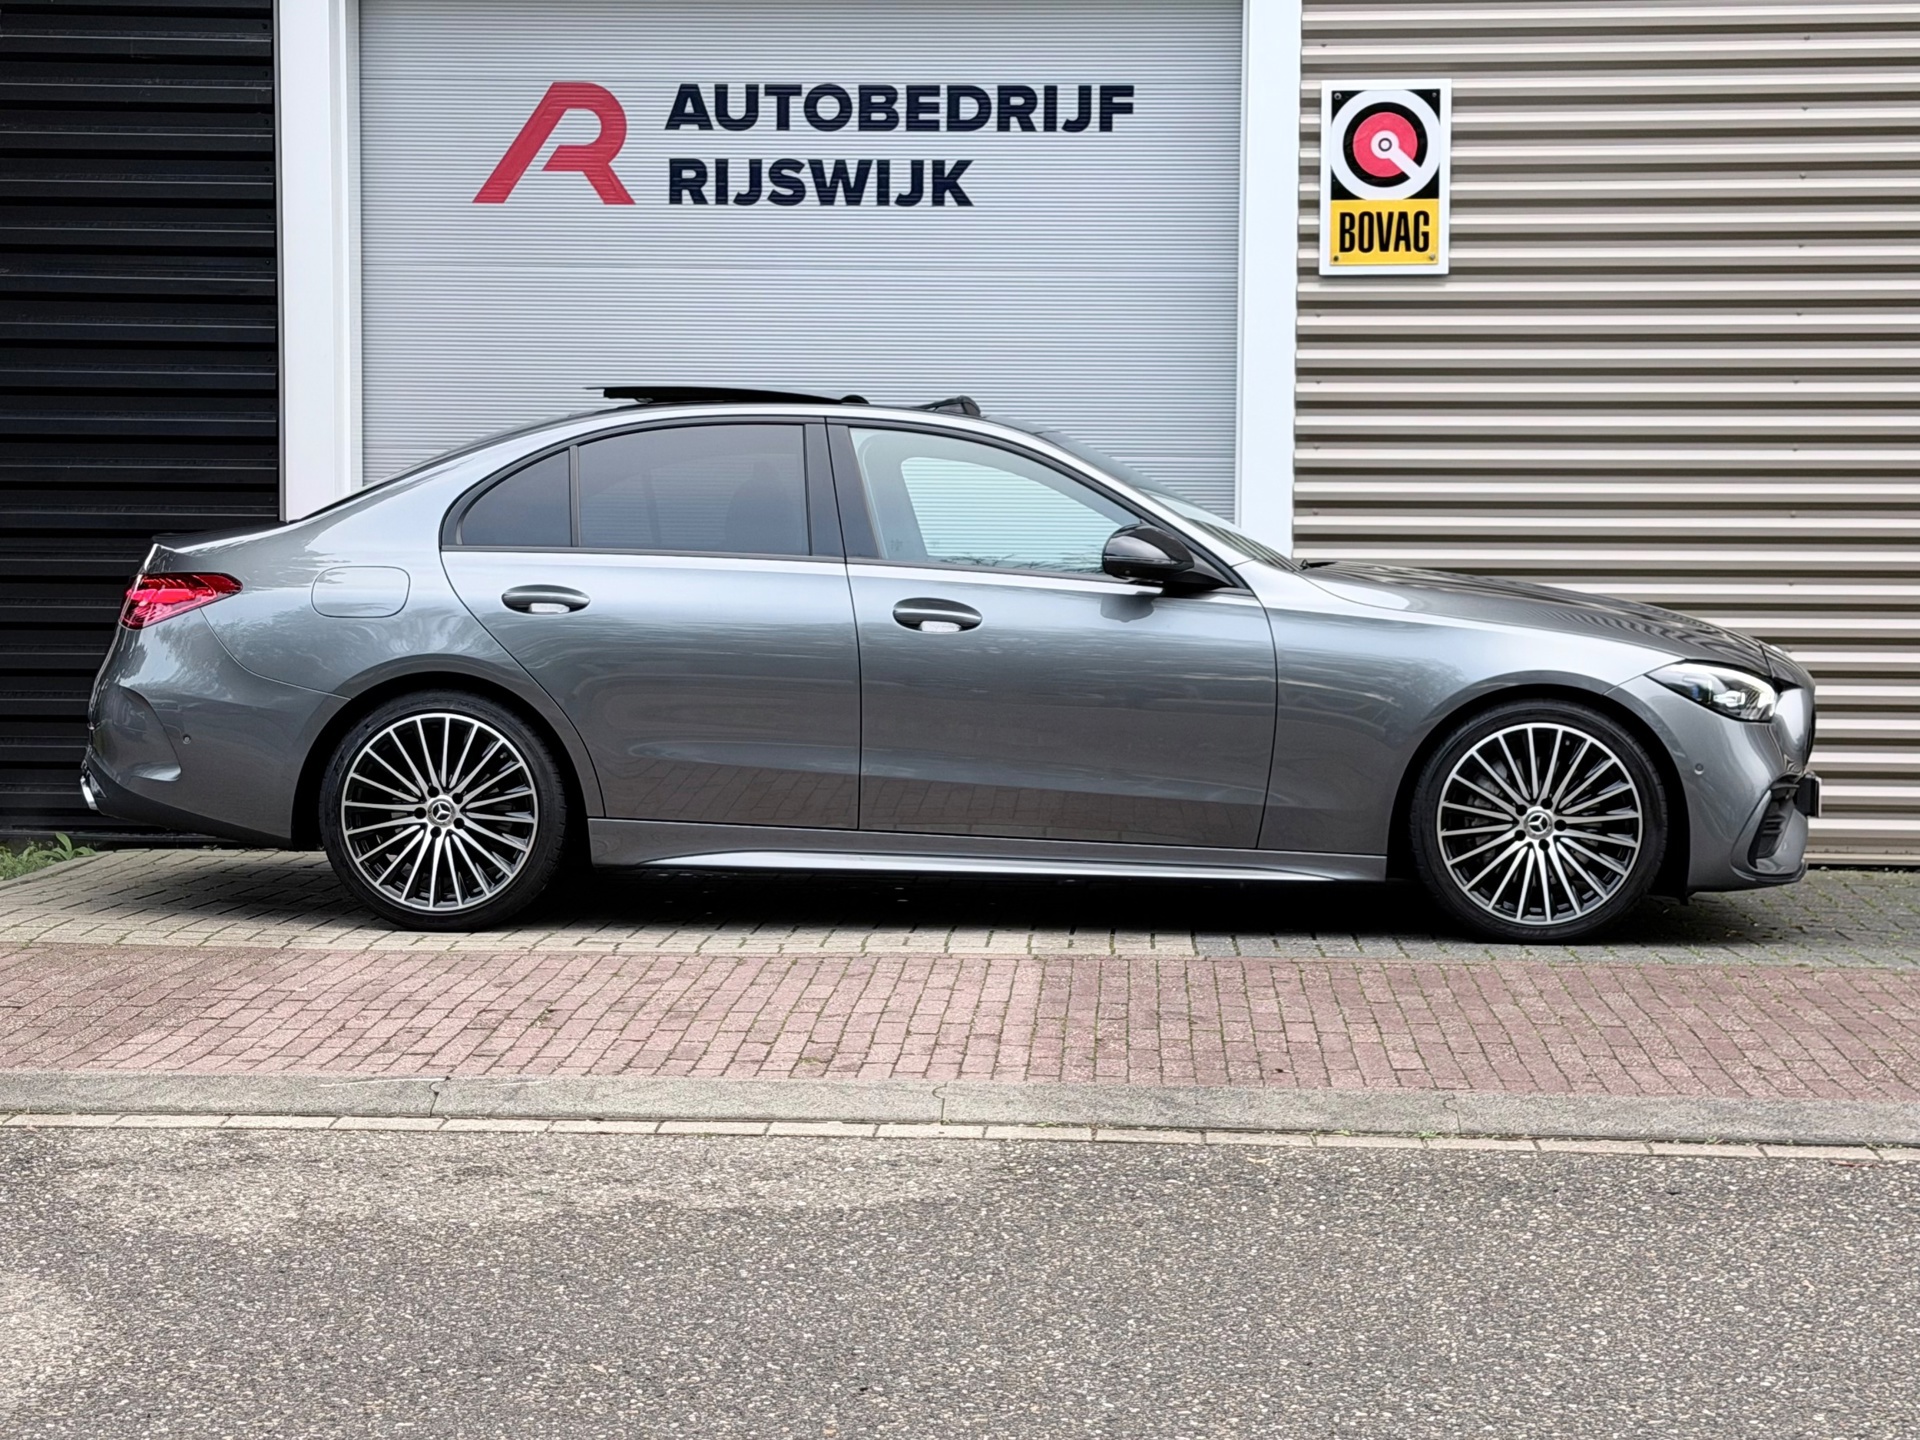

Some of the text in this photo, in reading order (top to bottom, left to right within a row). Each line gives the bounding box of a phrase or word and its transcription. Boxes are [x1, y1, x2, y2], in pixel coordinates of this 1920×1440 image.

[665, 83, 1135, 132] AUTOBEDRIJF
[668, 158, 974, 207] RIJSWIJK
[1339, 210, 1430, 253] BOVAG
